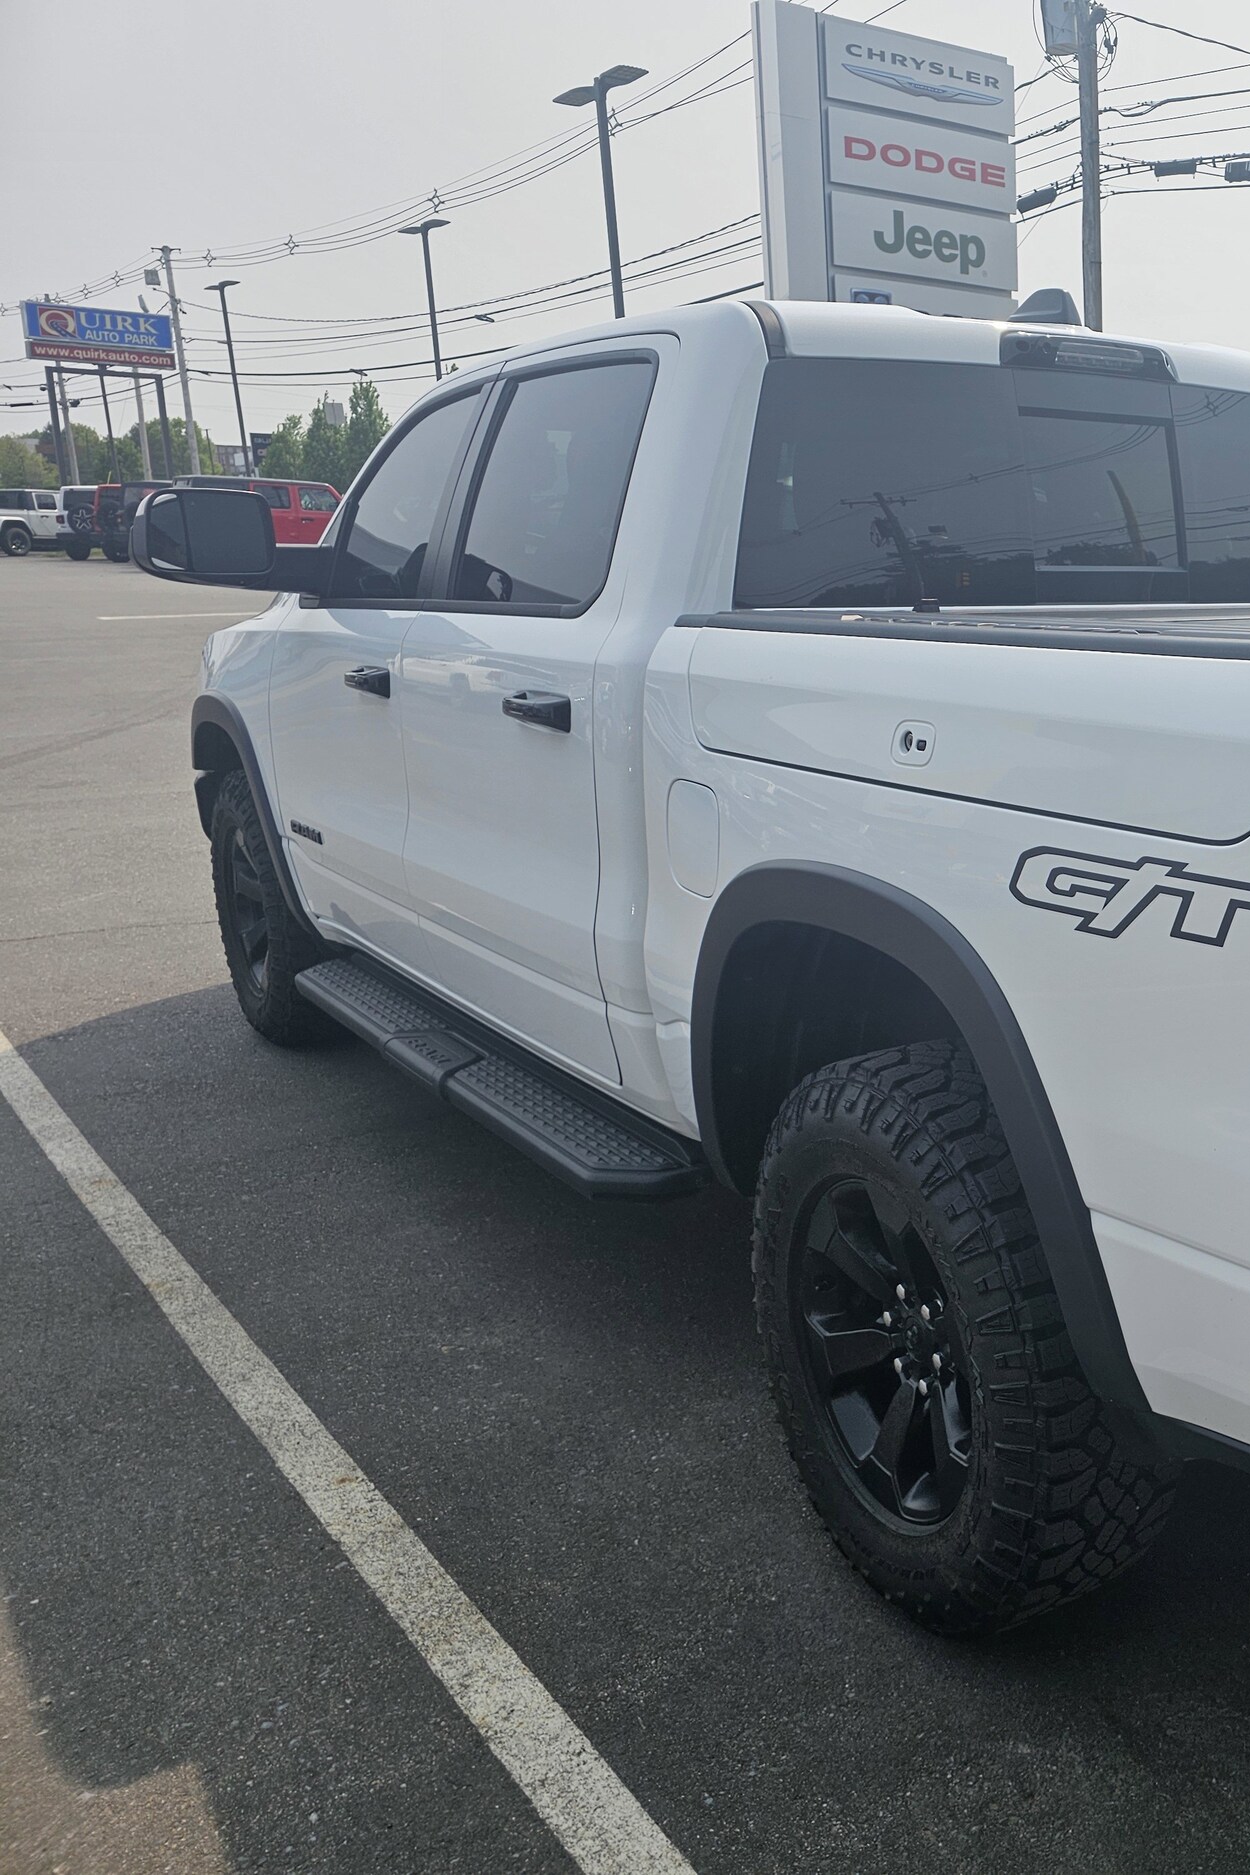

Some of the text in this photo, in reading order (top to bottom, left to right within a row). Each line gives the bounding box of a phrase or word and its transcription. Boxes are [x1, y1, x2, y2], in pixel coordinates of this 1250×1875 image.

[845, 43, 1000, 90] CHRYSLER
[843, 136, 1006, 188] DODGE
[873, 209, 986, 275] Jeep
[38, 309, 161, 339] QUIRK
[84, 329, 158, 346] AUTO PARK
[33, 346, 171, 366] www.quirkauto.com
